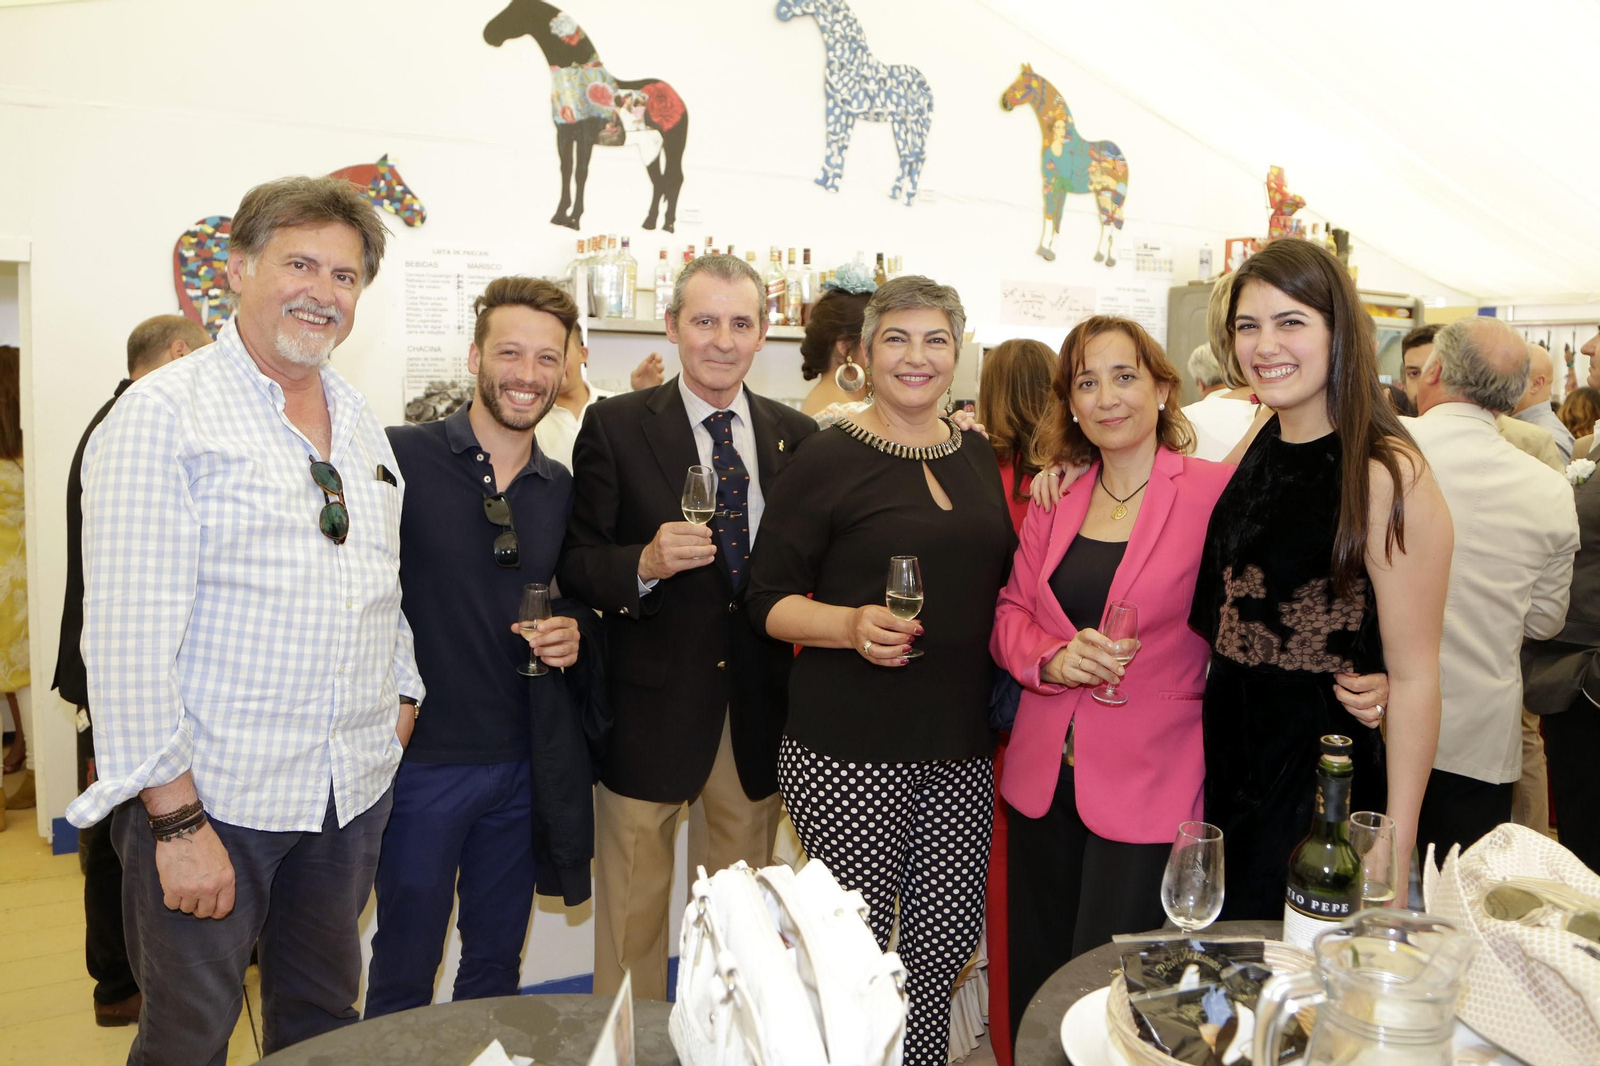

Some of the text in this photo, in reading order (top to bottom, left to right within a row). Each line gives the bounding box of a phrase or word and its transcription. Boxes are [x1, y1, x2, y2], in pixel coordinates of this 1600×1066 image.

[405, 260, 439, 268] BEBIDAS
[1287, 886, 1349, 913] TIO PEPE
[1155, 946, 1222, 980] Picos Artesanos
